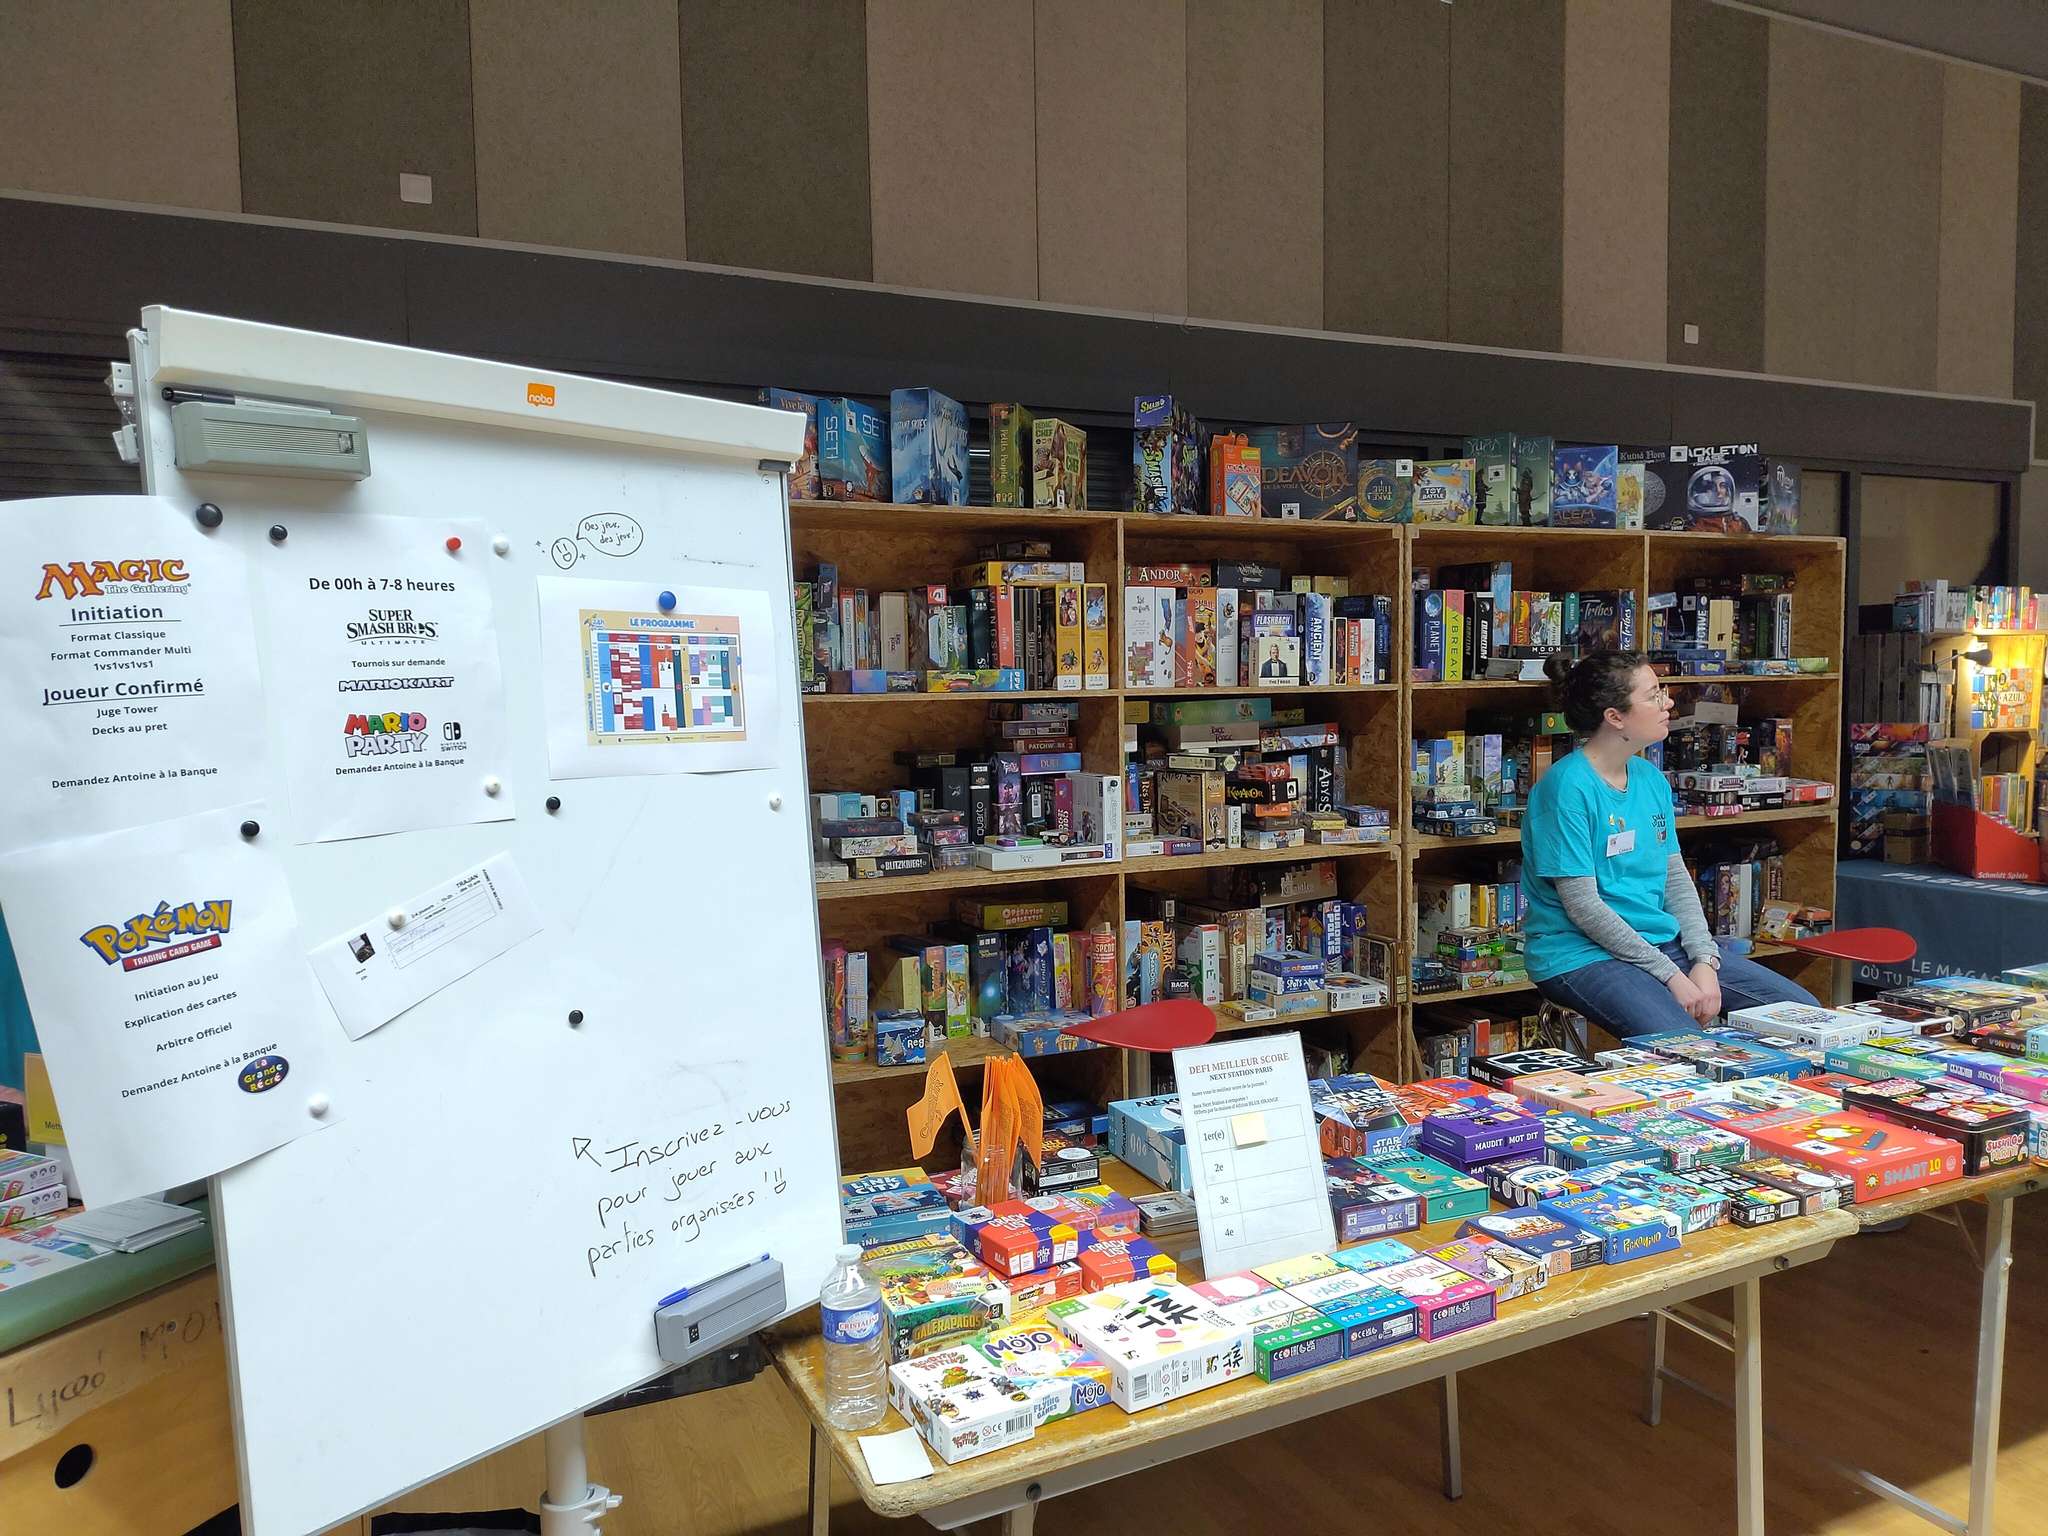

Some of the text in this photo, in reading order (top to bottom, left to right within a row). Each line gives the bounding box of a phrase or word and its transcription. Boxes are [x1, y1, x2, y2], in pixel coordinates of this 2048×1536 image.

[529, 392, 554, 404] nobo
[599, 532, 614, 543] des
[35, 560, 189, 600] MAGIC
[1139, 567, 1183, 583] ANDOR
[105, 583, 188, 596] The Gathering
[309, 578, 456, 592] De 00h à 7-8 heures
[71, 604, 163, 622] Initiation
[368, 609, 413, 622] SUPER
[1256, 615, 1292, 625] FLASHBACK
[347, 622, 394, 639] SMASH
[629, 617, 695, 629] LE PROGRAMME
[71, 629, 166, 643] Format Classique
[1313, 617, 1322, 660] ANCIENT
[1430, 620, 1440, 656] PLANET
[50, 645, 192, 661] Format Commander Multi
[94, 660, 154, 671] 1vs1vs1vs1
[352, 657, 446, 668] Tournois sur demande
[42, 678, 204, 706] Joueur Confirmé
[338, 676, 455, 692] MARIOKART
[97, 704, 158, 718] Juge Tower
[92, 722, 168, 736] Decks au pret
[344, 712, 427, 735] MARIO
[345, 732, 428, 758] PARTY
[1028, 742, 1066, 750] PATCHWRK
[335, 756, 465, 775] Demandez Antoine à la Banque
[51, 765, 218, 789] Demandez Antoine à la Banque
[1318, 767, 1332, 812] ABYSS
[885, 859, 923, 870] BLITZKRIEG!
[1978, 871, 2028, 881] Schmidt Spiele
[132, 938, 213, 966] TRADING CARD GAME
[1148, 951, 1158, 986] Seasons
[1860, 963, 1902, 986] OÙ TU
[1911, 959, 1930, 974] LE
[134, 971, 219, 1002] Initiation au jeu
[1171, 981, 1189, 989] BACK
[124, 990, 238, 1030] Explication des cartes
[156, 1022, 233, 1053] Arbitre Officiel
[121, 1042, 278, 1099] Demandez Antoine à la Banque
[255, 1058, 269, 1070] La
[1188, 1052, 1290, 1075] DEFI MEILLEUR SCORE
[243, 1063, 284, 1084] Grande
[1209, 1065, 1273, 1081] NEXT STATION PARIS
[249, 1073, 283, 1093] Récré
[1202, 1131, 1225, 1143] 1er(e)
[1375, 1135, 1402, 1147] STAR
[1475, 1131, 1539, 1151] MAUDIT MOT DIT
[1986, 1137, 2011, 1153] SUSHI
[605, 1122, 725, 1172] Inscrivez
[1373, 1145, 1402, 1155] WARS
[1214, 1161, 1224, 1172] 2e
[1883, 1158, 1942, 1186] SMART 10
[597, 1142, 773, 1229] pour jouer aux
[853, 1182, 901, 1196] CITY
[1219, 1193, 1229, 1205] 3e
[988, 1213, 1027, 1229] CRACK
[1007, 1219, 1033, 1231] LIST
[587, 1187, 756, 1278] parties organisées
[1224, 1226, 1235, 1238] 4e
[1088, 1239, 1131, 1253] CRACK
[1623, 1231, 1662, 1253] PICKOMINO
[1102, 1245, 1131, 1258] LIST
[1378, 1261, 1446, 1286] LONDON
[1311, 1278, 1360, 1299] PARIS
[1138, 1294, 1199, 1325] INK
[1033, 1398, 1060, 1414] FLYING
[1036, 1405, 1058, 1420] GAMES
